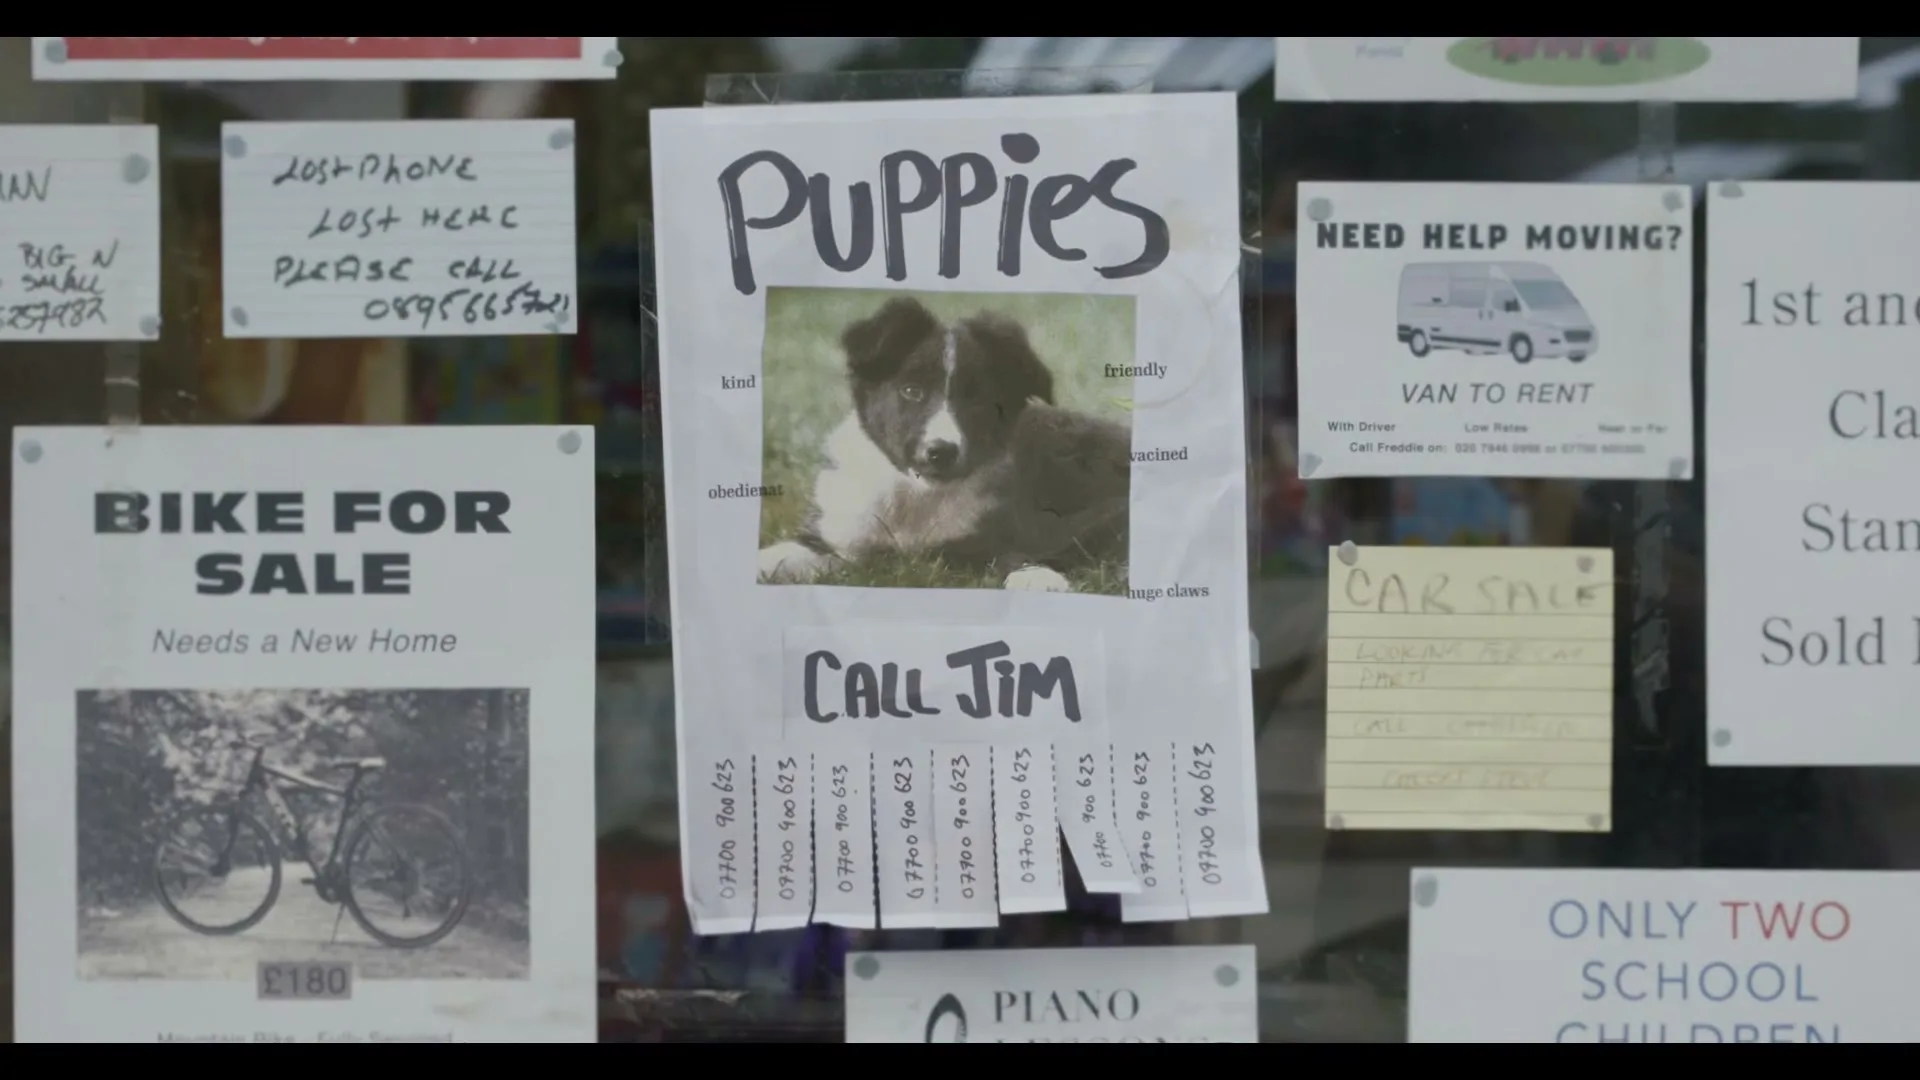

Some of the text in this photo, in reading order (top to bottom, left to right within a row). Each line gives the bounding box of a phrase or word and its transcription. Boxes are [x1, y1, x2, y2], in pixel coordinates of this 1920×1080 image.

[309, 206, 401, 239] LOST
[1317, 222, 1682, 251] NEED HELP MOVING?
[448, 257, 521, 284] CALL
[1741, 277, 1821, 326] 1st
[721, 374, 756, 390] kind
[1104, 362, 1167, 381] friendly
[1401, 383, 1594, 404] VAN TO RENT
[1328, 421, 1396, 432] With Driver
[1129, 446, 1188, 463] vacined
[1350, 442, 1373, 453] Call
[1378, 442, 1424, 453] Freddie
[708, 483, 785, 500] obedienat
[94, 490, 512, 534] BIKE FOR
[195, 553, 411, 596] SALE
[1167, 582, 1209, 599] claws
[1345, 568, 1600, 614] CAR SALE
[152, 629, 457, 654] Needs a New Home
[1761, 615, 1886, 667] Sold
[804, 649, 941, 723] CALL
[712, 758, 735, 792] 623
[773, 756, 797, 794] 623
[894, 756, 913, 793] 623
[950, 754, 970, 792] 623
[1011, 747, 1032, 782] 623
[1076, 753, 1094, 787] 623
[1133, 752, 1150, 785] 623
[1188, 742, 1215, 780] 623
[831, 764, 856, 892] 07700 900 623
[1549, 900, 1850, 940] ONLY TWO
[262, 967, 347, 996] £180
[1582, 961, 1819, 1002] SCHOOL
[993, 988, 1141, 1023] PIANO
